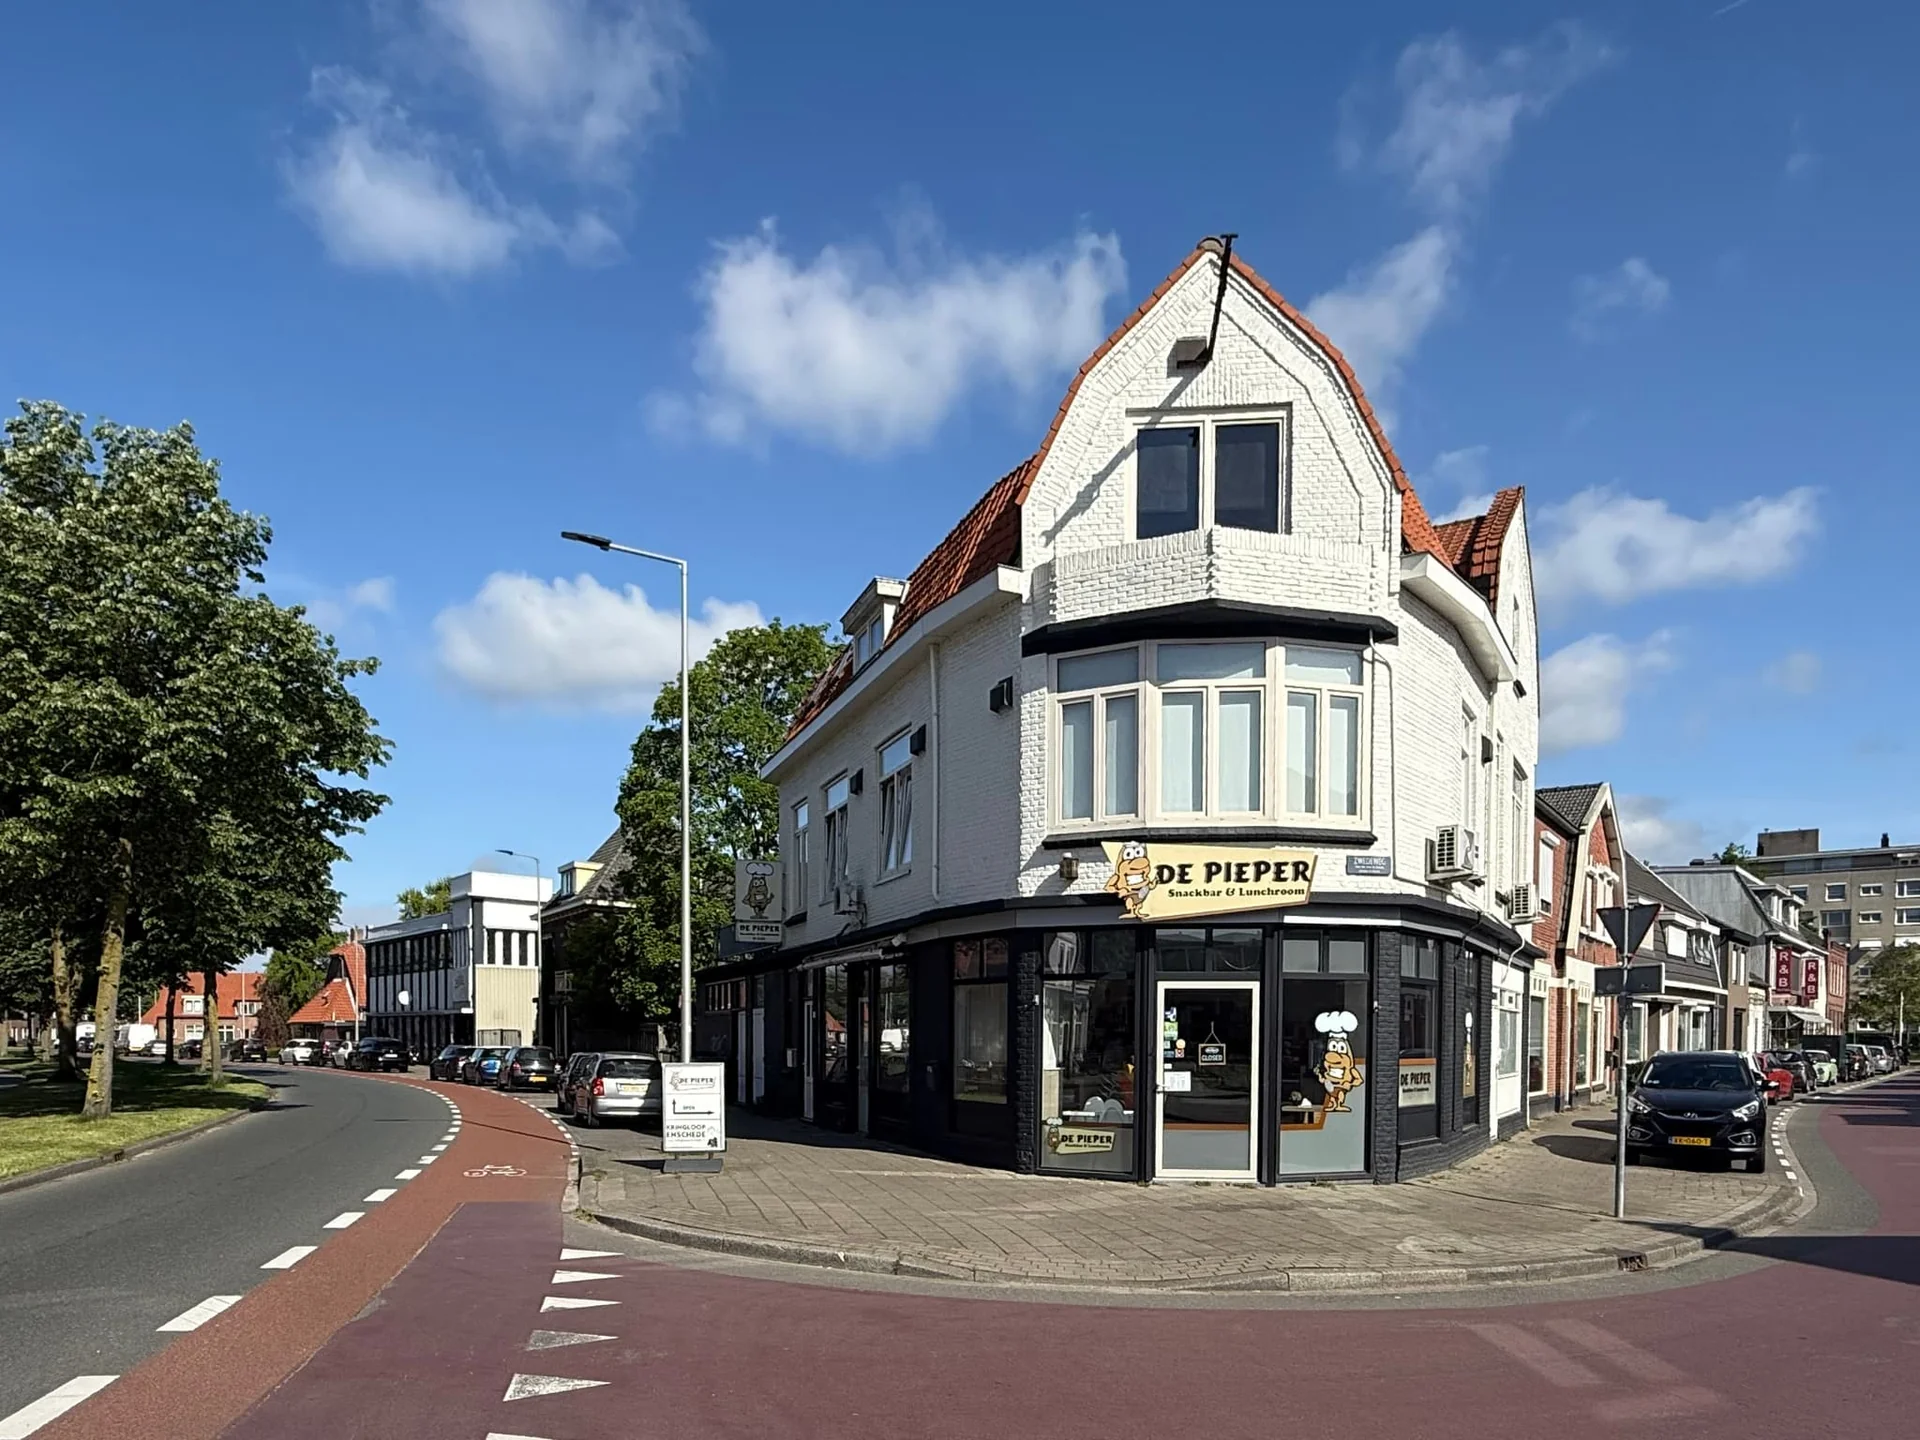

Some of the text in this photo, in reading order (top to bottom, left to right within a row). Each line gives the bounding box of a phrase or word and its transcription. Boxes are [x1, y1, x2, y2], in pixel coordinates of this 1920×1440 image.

[1155, 861, 1311, 884] DE PIEPER
[1168, 887, 1305, 897] Snackbar & Lunchroom
[752, 924, 780, 932] PIEPER
[1400, 1072, 1431, 1086] DE PIEPER
[1061, 1134, 1112, 1144] DE PIEPER
